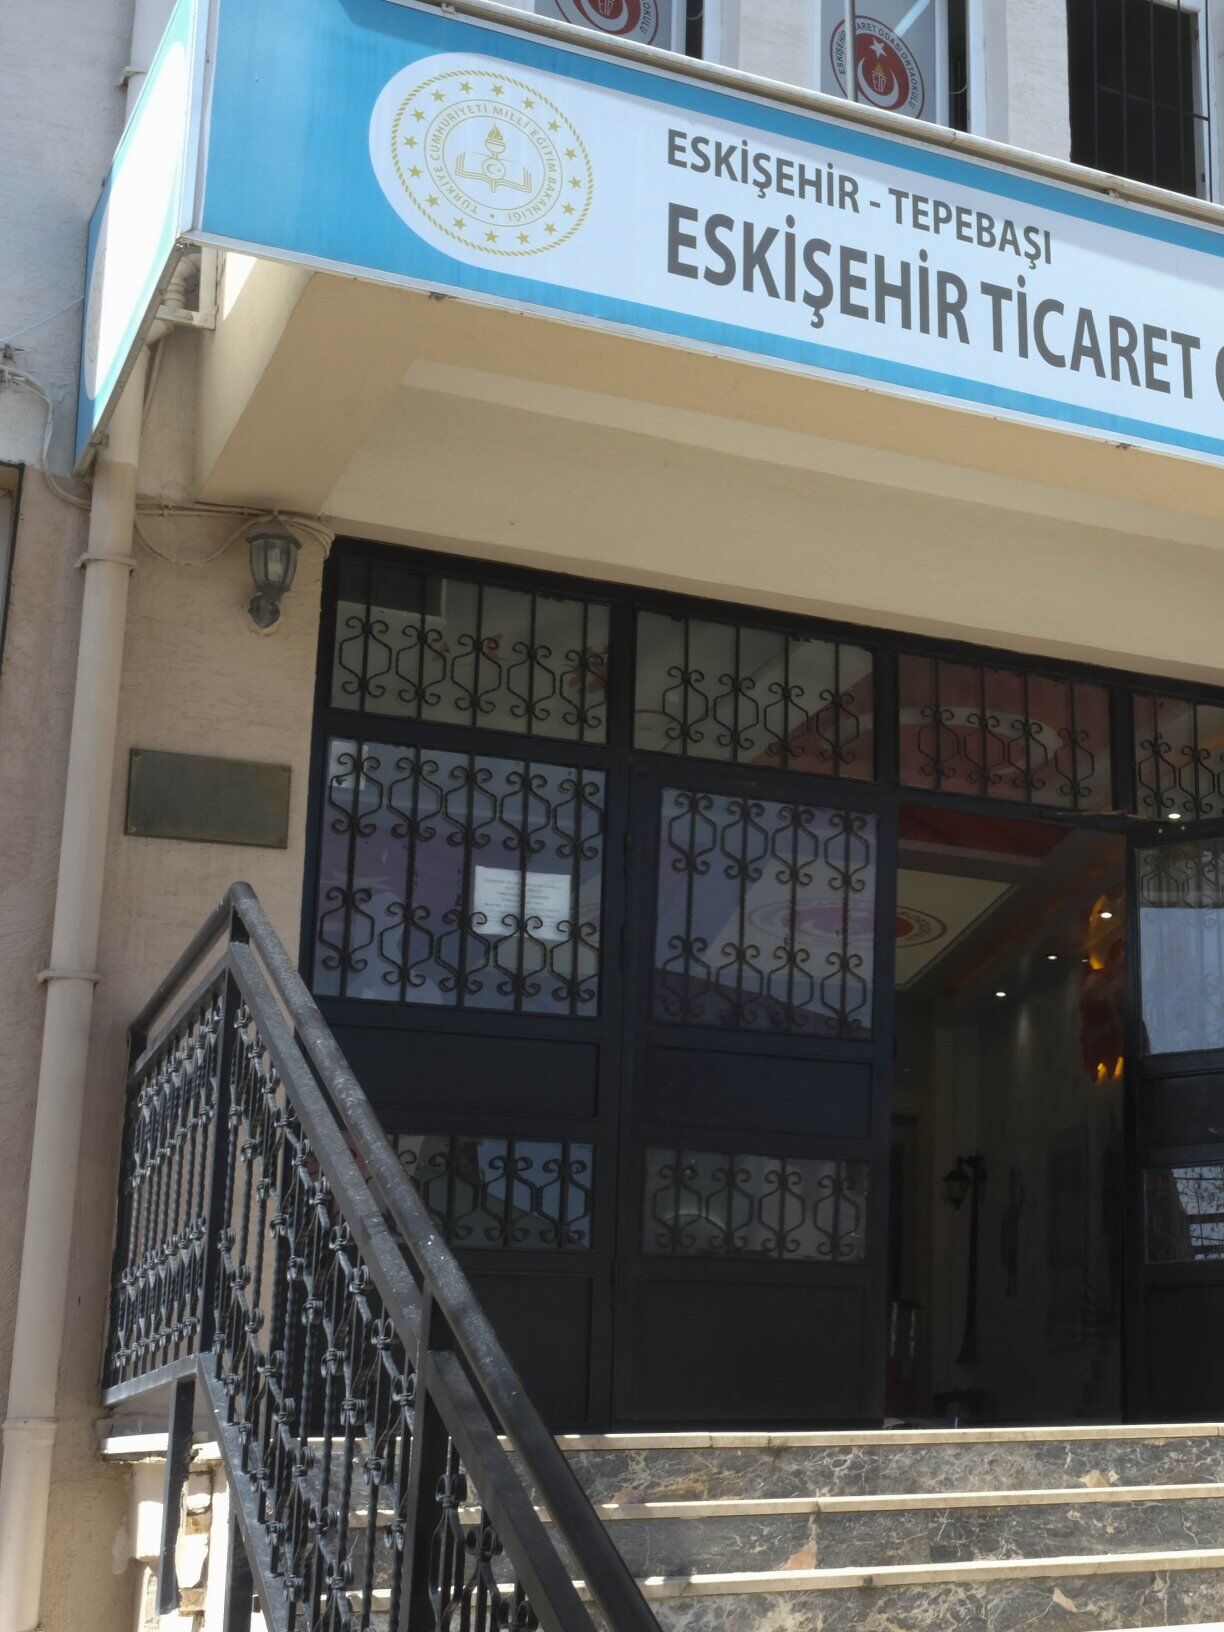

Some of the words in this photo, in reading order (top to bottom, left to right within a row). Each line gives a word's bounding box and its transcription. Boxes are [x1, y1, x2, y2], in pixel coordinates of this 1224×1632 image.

[640, 0, 652, 35] OKULU
[855, 22, 876, 33] ARET
[878, 28, 903, 53] ODASI
[901, 52, 919, 109] ORTAOKULU
[430, 104, 488, 161] CUMHURİYETİ
[530, 129, 557, 173] EĞİTİM
[433, 165, 479, 214] TÜRKİYE
[507, 177, 558, 222] BAKANLIĞI
[667, 128, 860, 214] ESKİŞEHİR
[888, 187, 1052, 269] TEPEBAŞI
[667, 202, 970, 345] ESKİŞEHİR
[980, 274, 1201, 399] TİCARET
